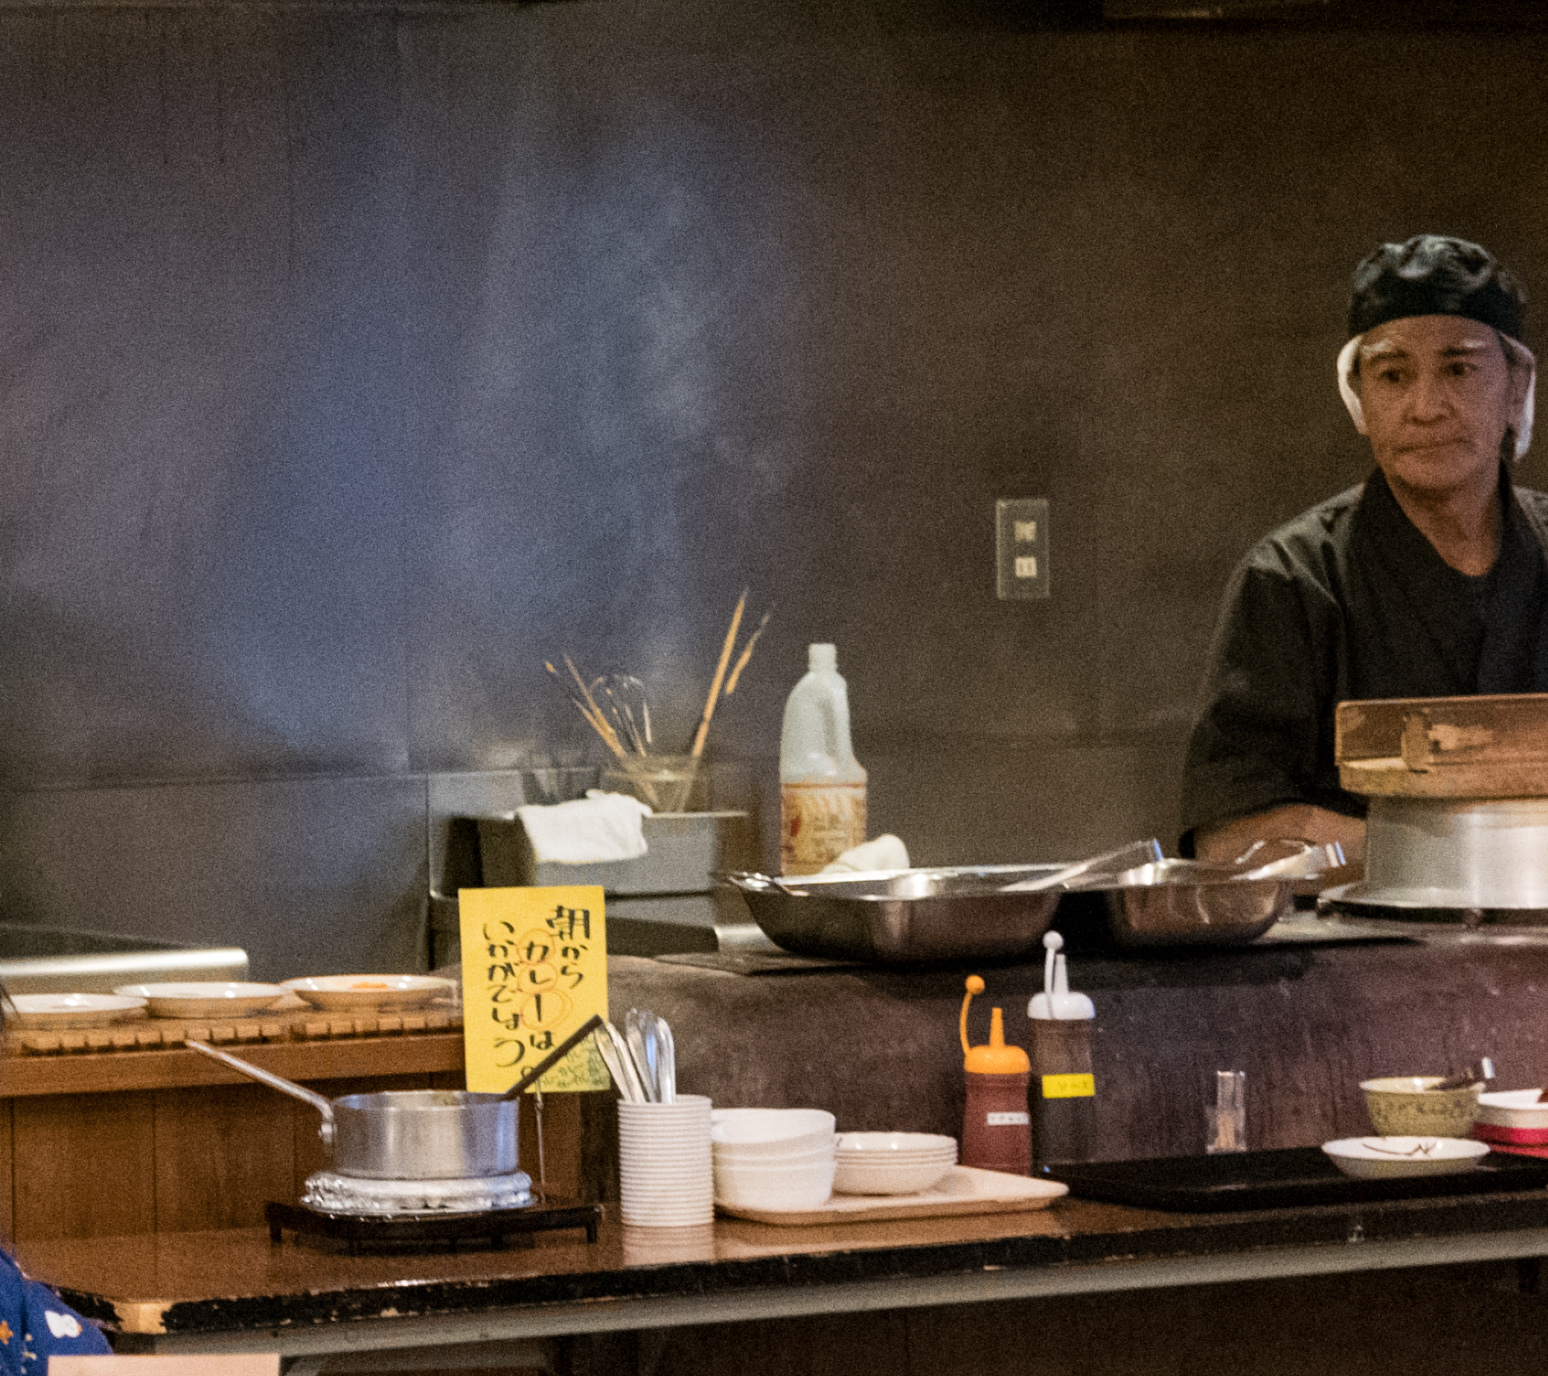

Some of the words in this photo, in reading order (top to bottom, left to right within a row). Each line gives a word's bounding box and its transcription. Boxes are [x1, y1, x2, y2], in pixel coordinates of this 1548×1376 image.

[523, 940, 555, 1051] カレーは
[545, 905, 592, 990] 朝から
